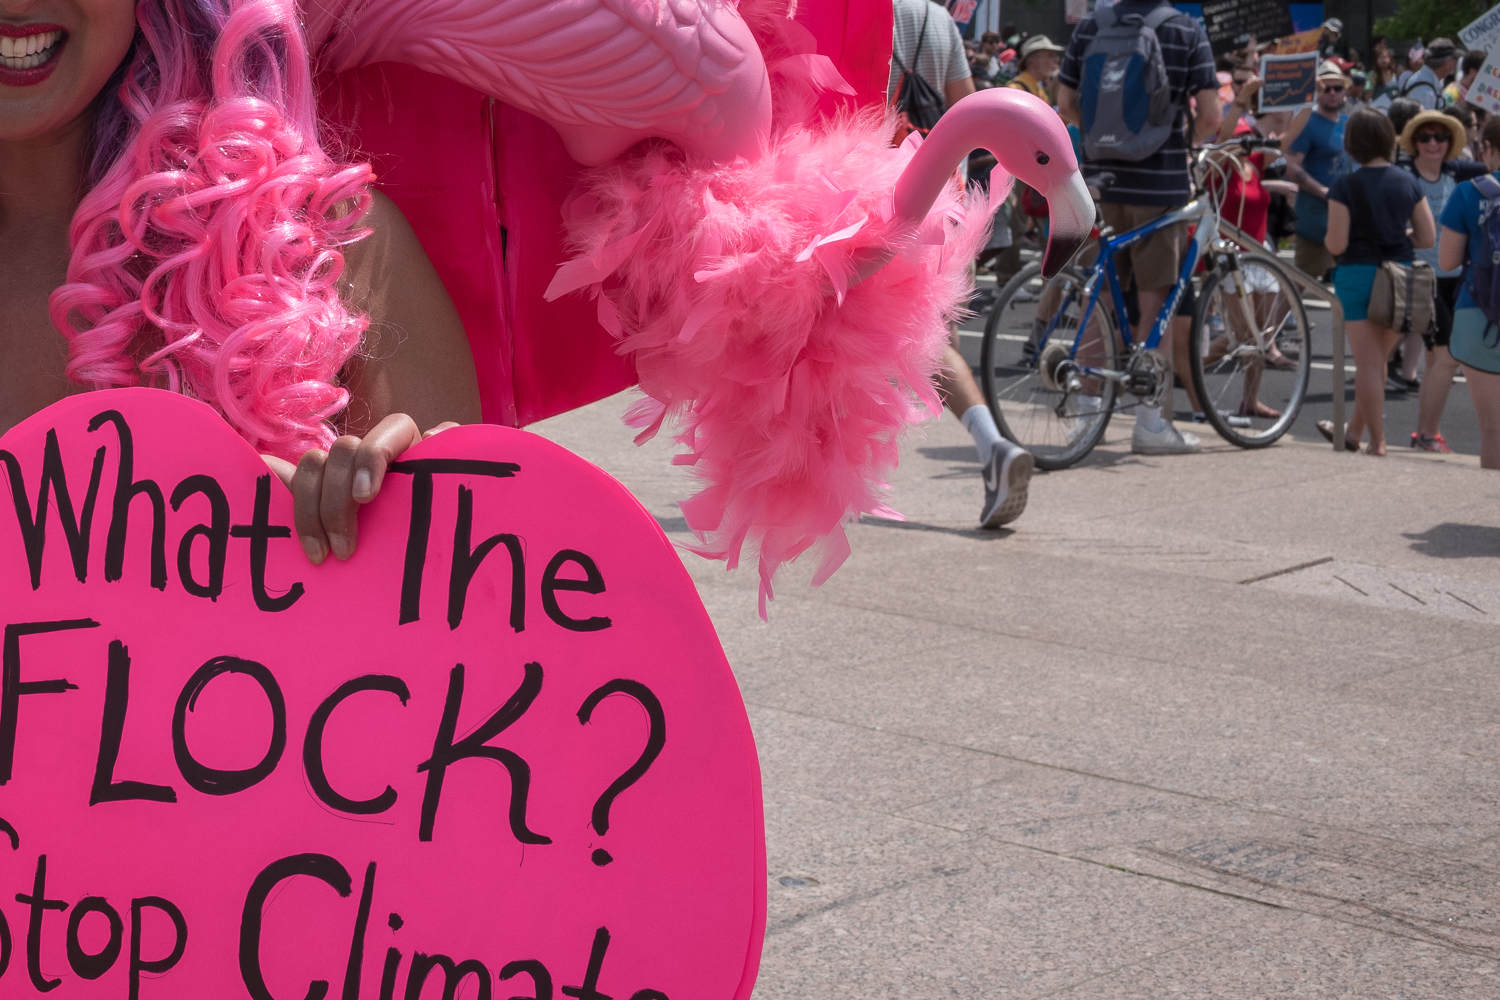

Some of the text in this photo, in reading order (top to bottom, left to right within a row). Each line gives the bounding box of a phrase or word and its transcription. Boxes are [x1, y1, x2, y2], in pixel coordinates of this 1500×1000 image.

[1462, 6, 1500, 44] CONGR
[387, 459, 613, 633] The
[239, 853, 670, 1000] Climat
